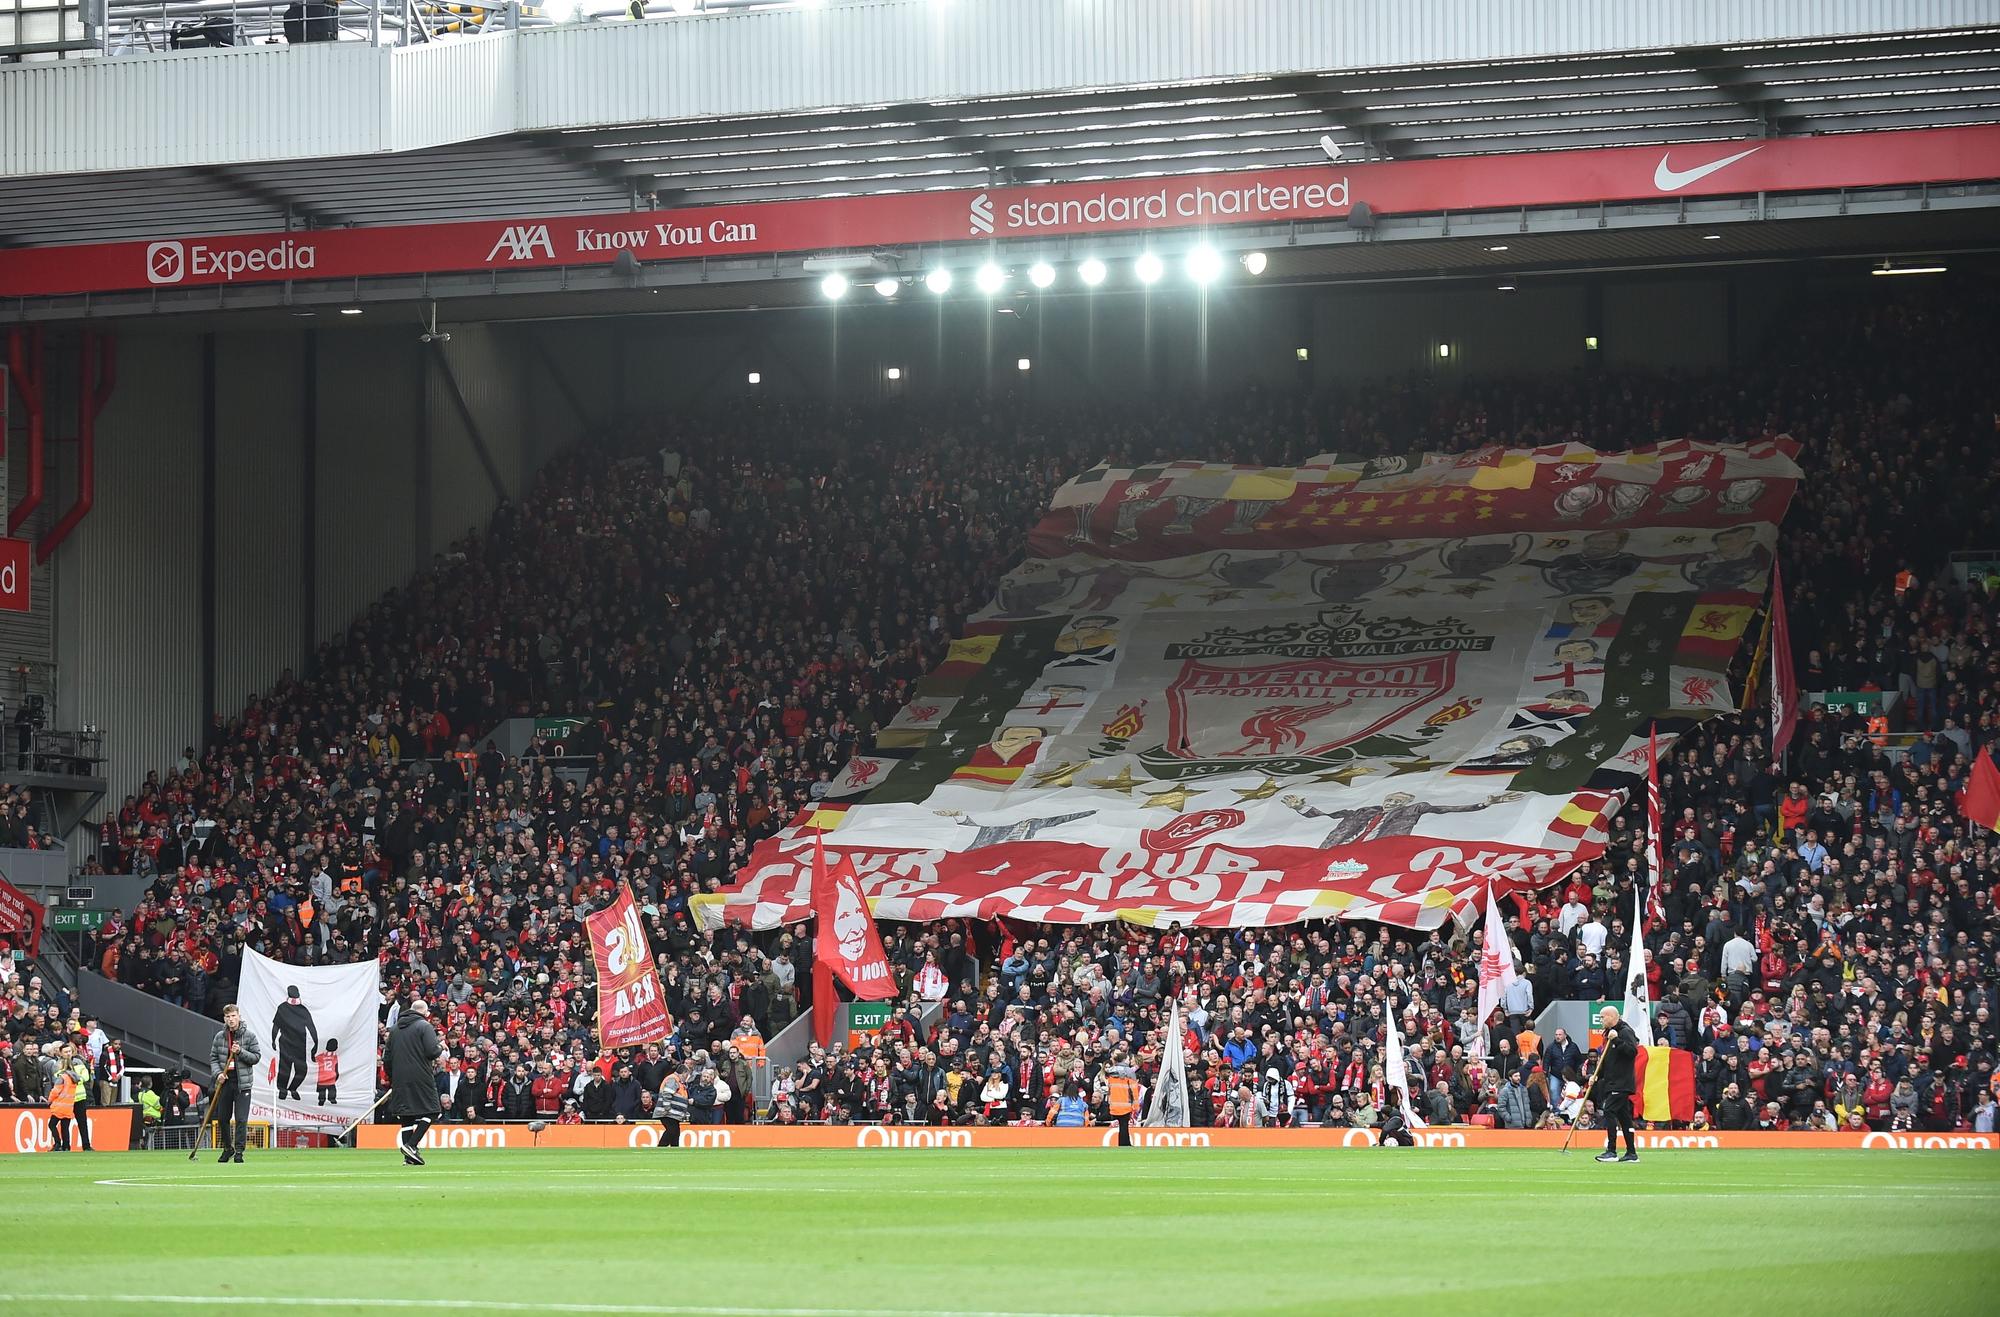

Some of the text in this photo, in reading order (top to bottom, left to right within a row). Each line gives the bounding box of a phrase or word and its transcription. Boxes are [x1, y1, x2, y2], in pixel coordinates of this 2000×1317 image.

[1006, 177, 1350, 228] standard chartered
[485, 225, 556, 261] AXA
[576, 220, 758, 251] Know You Can
[191, 239, 316, 280] Expedia
[1342, 641, 1408, 656] WALK
[1413, 638, 1486, 651] ALONE
[1195, 665, 1436, 688] LIVERPOOL
[1347, 688, 1419, 699] CLUB
[54, 914, 77, 925] EXIT
[855, 1014, 881, 1025] EXIT
[323, 1060, 333, 1071] 12
[251, 1105, 269, 1116] OFF
[283, 1109, 300, 1121] THE
[303, 1113, 334, 1122] MATCH
[336, 1116, 351, 1124] WE
[628, 1124, 731, 1148] Qorn
[857, 1125, 972, 1147] Quorn
[1861, 1131, 1991, 1149] Quorn
